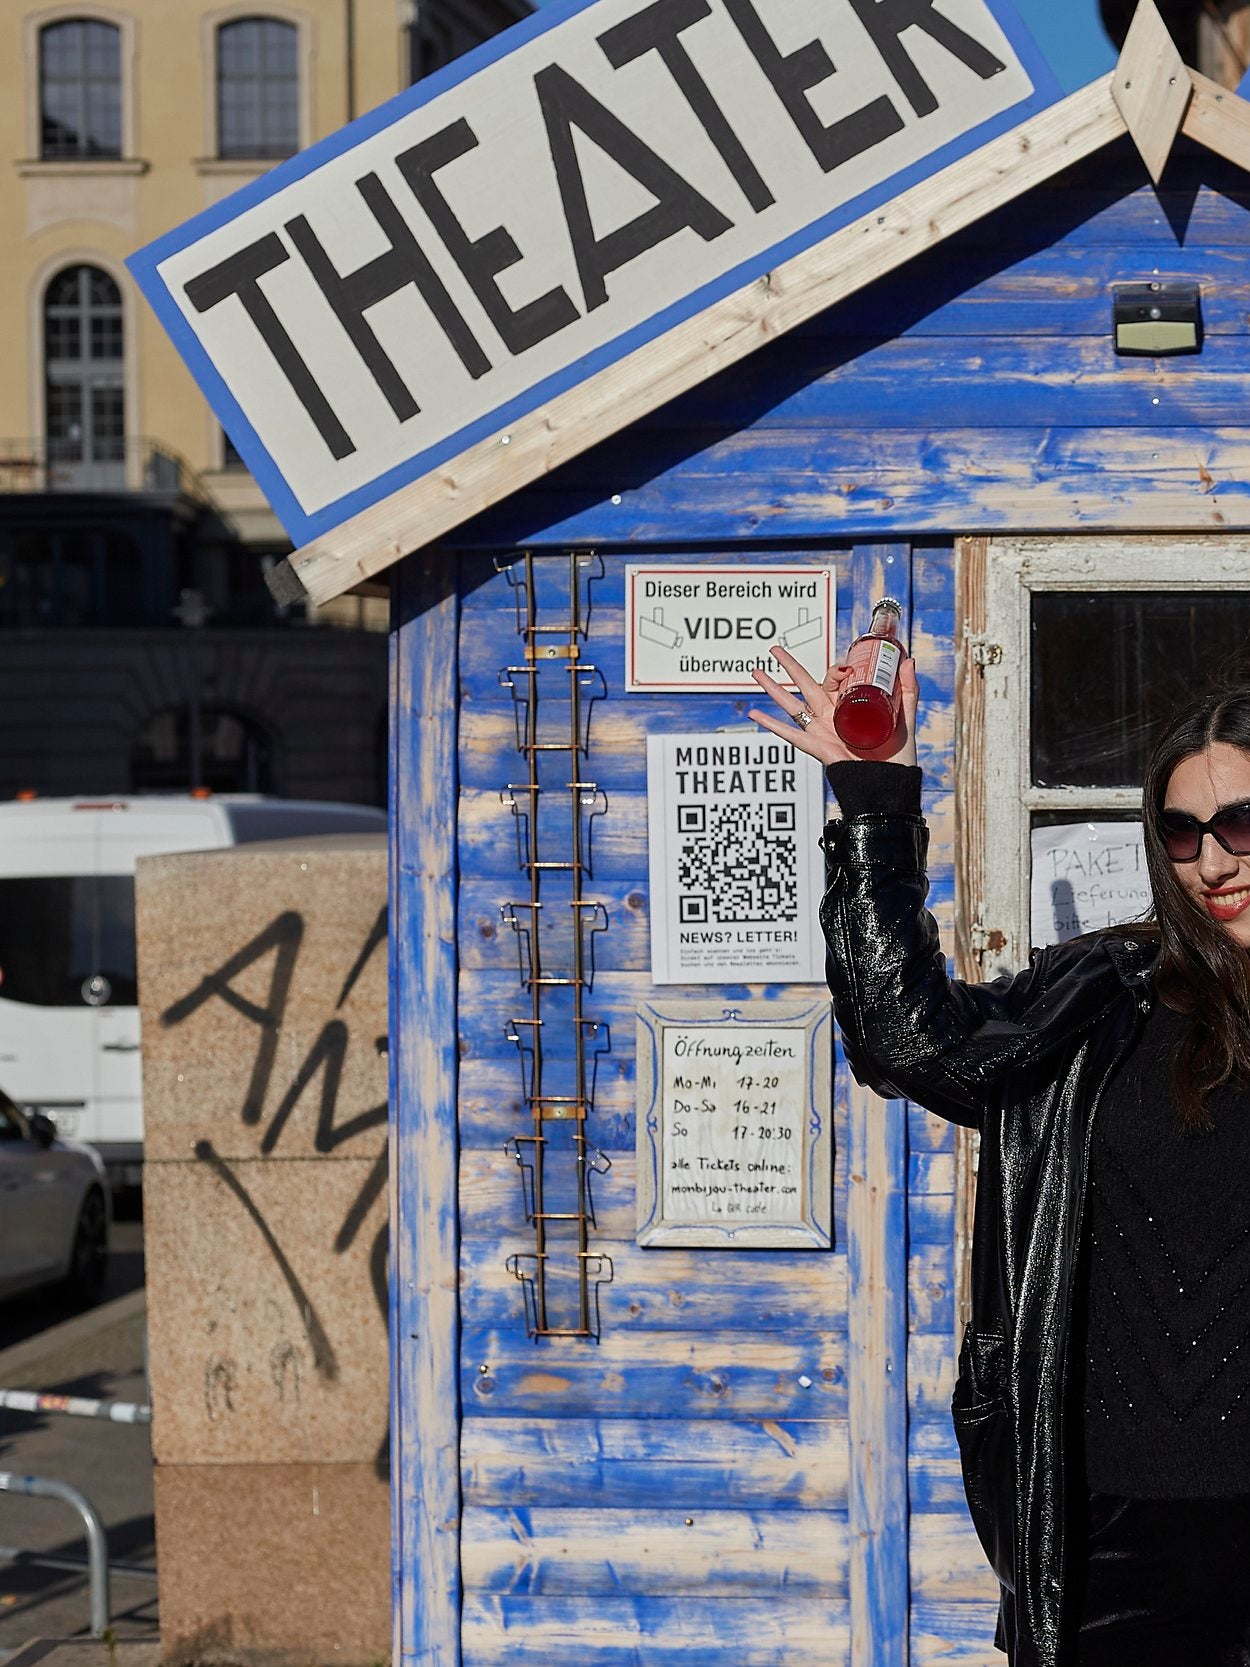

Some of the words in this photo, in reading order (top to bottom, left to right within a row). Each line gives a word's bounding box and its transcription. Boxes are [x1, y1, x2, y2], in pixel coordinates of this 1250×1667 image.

[645, 581, 700, 598] Dieser
[706, 581, 772, 598] Bereich
[778, 581, 817, 598] wird
[684, 617, 777, 640] VIDEO
[676, 745, 796, 767] MONBIJOU
[675, 769, 797, 794] THEATER
[1047, 843, 1143, 879] PAKET
[680, 932, 732, 944] NEWS?
[737, 931, 798, 943] LETTER!
[671, 1122, 688, 1137] So
[697, 1157, 740, 1171] Tickets
